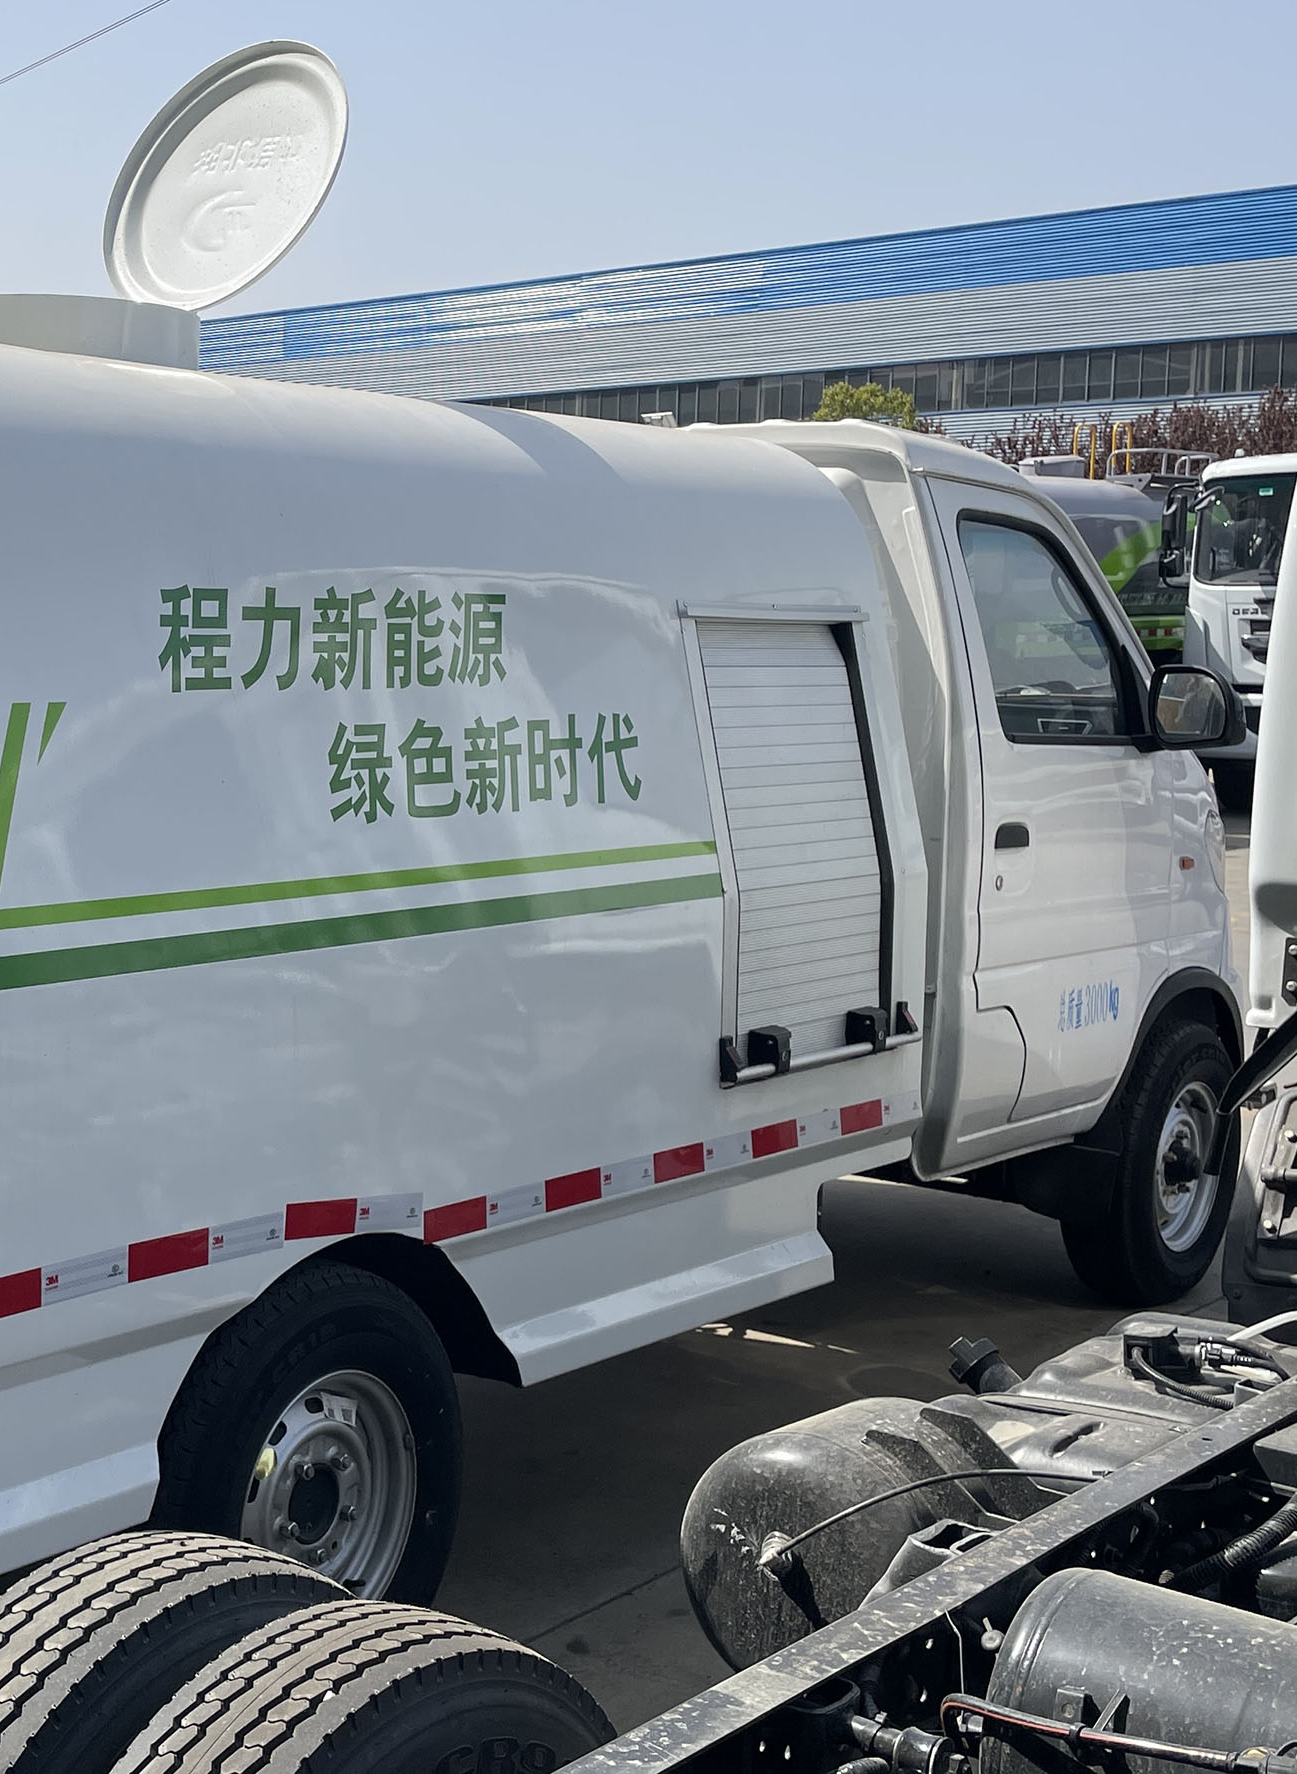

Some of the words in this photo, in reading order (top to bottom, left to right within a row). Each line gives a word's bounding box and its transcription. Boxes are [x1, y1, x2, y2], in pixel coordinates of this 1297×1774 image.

[158, 584, 507, 693] 程力新能源
[328, 712, 643, 824] 绿色新时代
[213, 1235, 224, 1246] 3M
[46, 1275, 60, 1287] 3M
